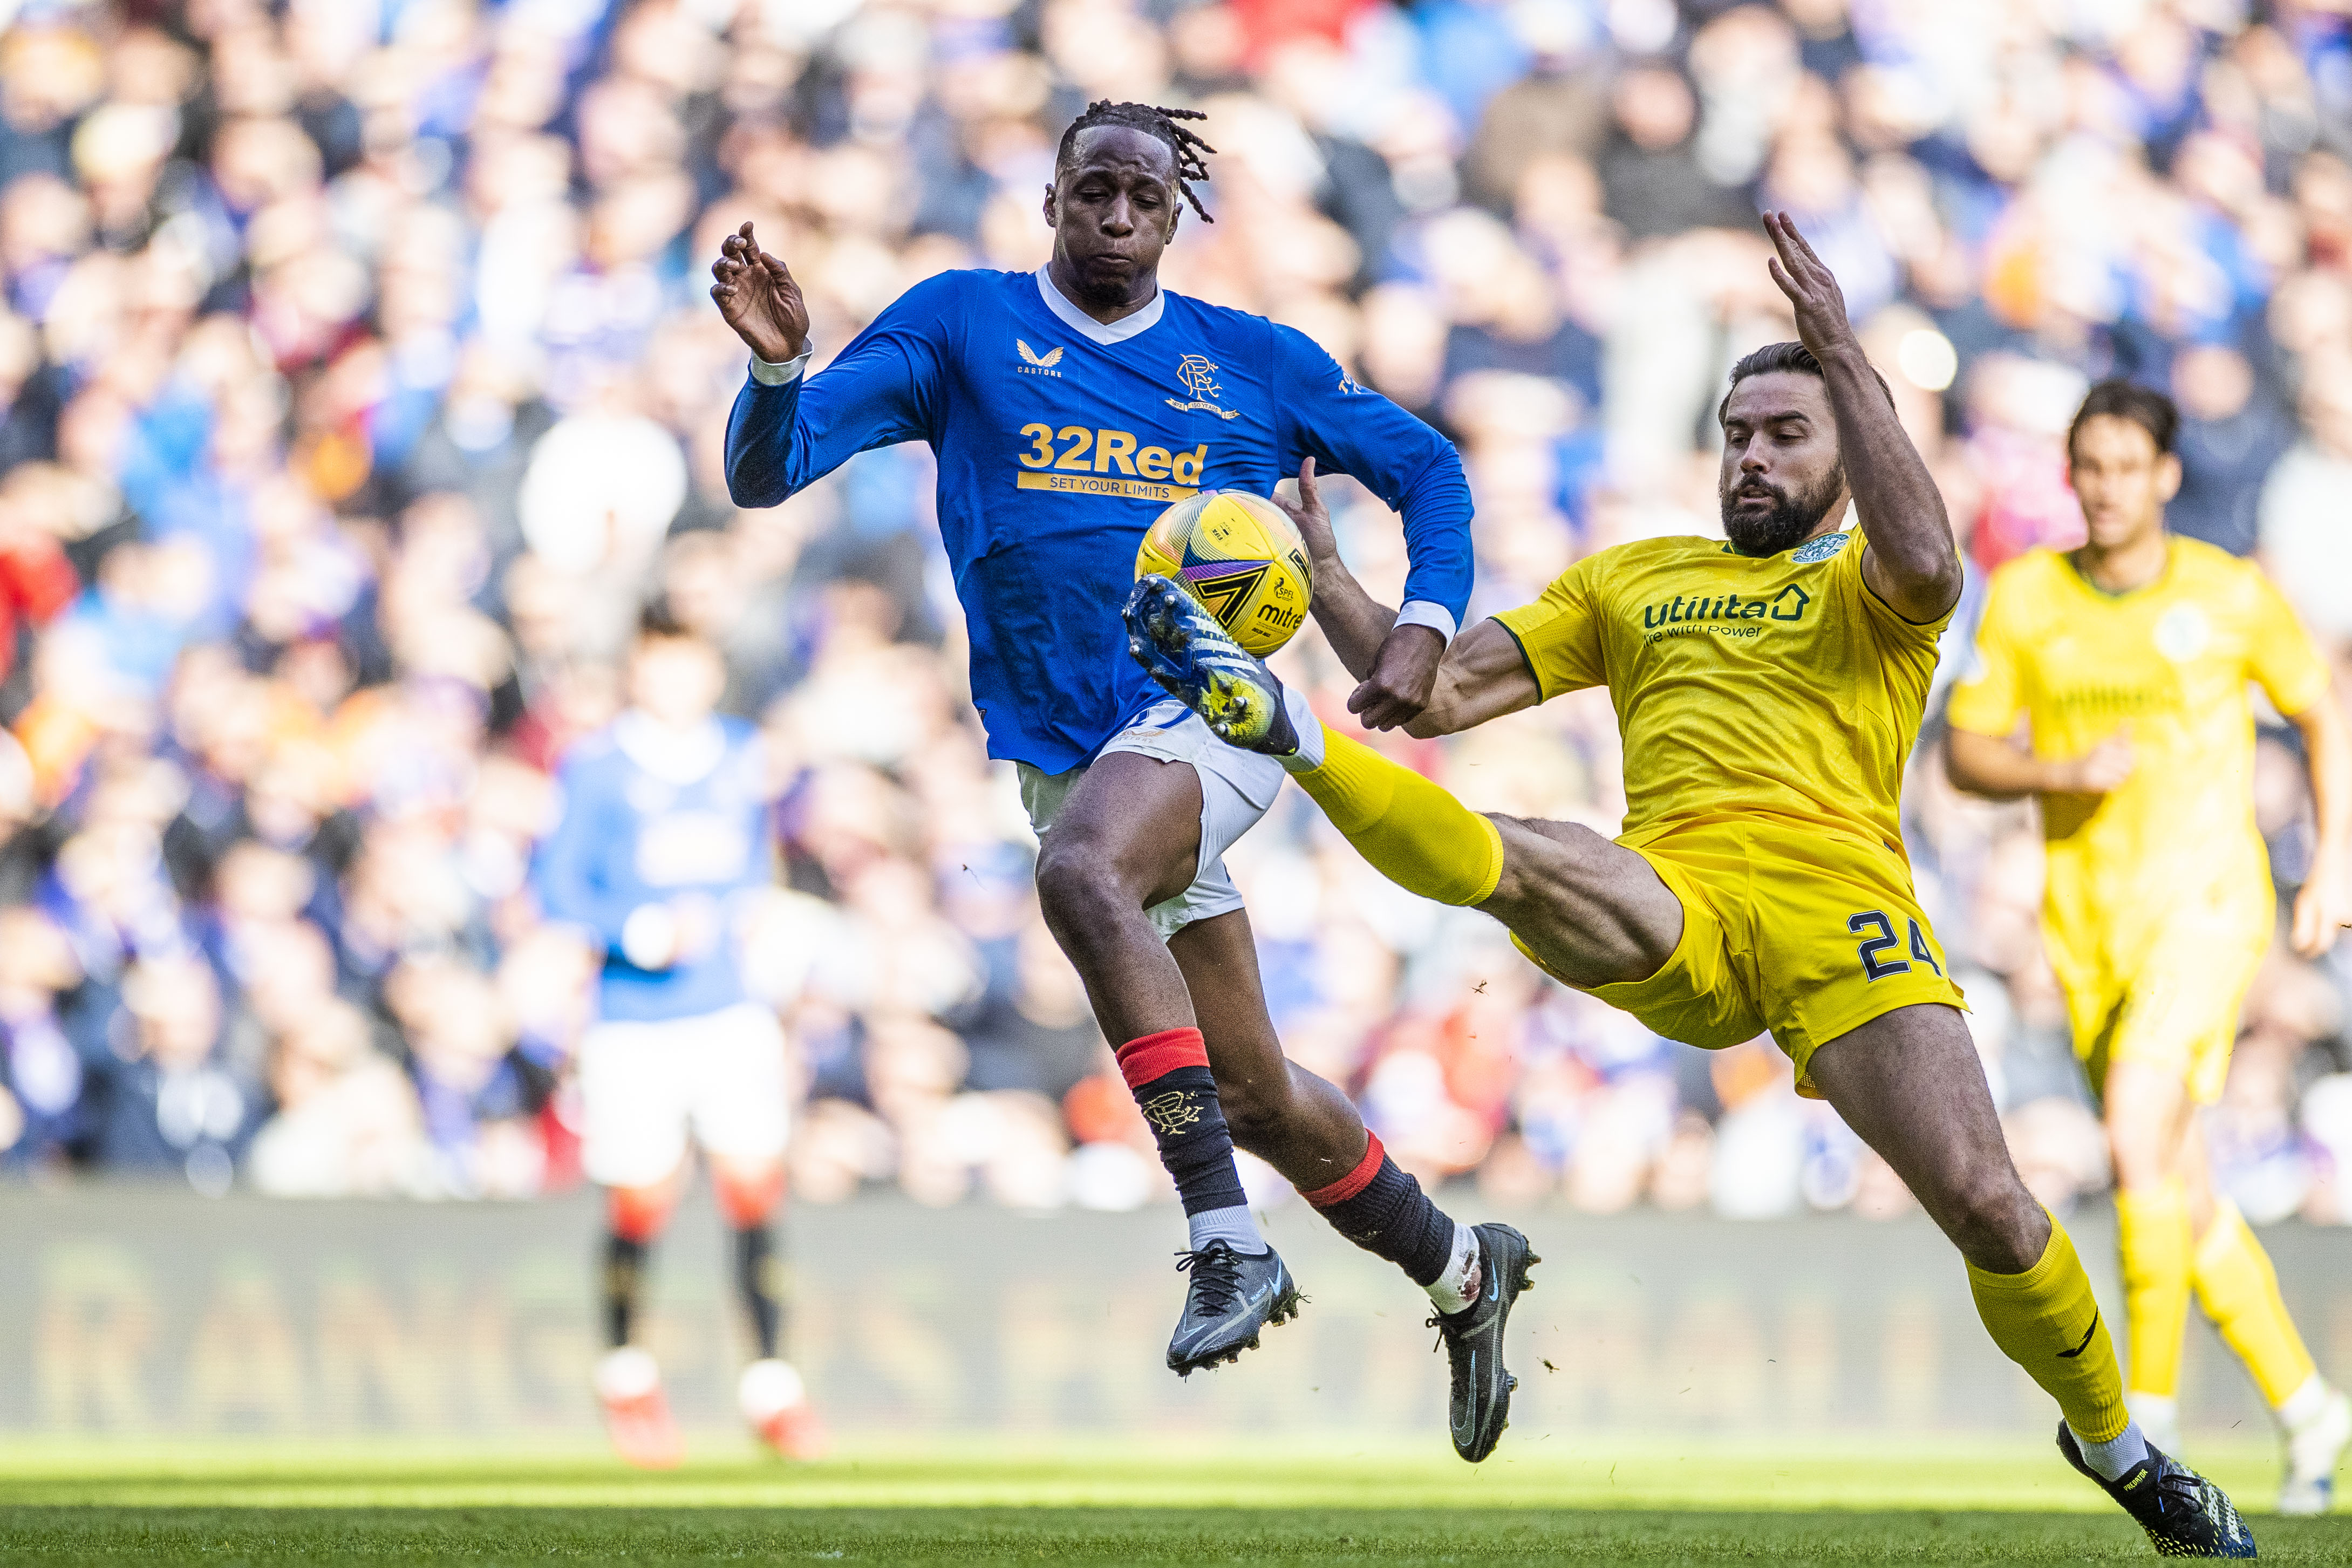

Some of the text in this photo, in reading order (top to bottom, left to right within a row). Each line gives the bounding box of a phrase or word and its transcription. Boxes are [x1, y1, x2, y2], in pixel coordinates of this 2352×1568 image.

[1018, 366, 1062, 378] CASTORE
[1202, 403, 1218, 412] YEARS
[1019, 423, 1208, 485] 32Red
[1050, 478, 1169, 498] SET YOUR LIMITS
[1210, 529, 1223, 541] FIFA
[1279, 587, 1294, 599] SPFL
[1257, 604, 1303, 630] mitre
[1645, 594, 1767, 629] utilita
[1667, 624, 1703, 640] with
[1707, 625, 1763, 638] power
[1846, 909, 1942, 983] 24
[2123, 1469, 2148, 1491] PREDATOR
